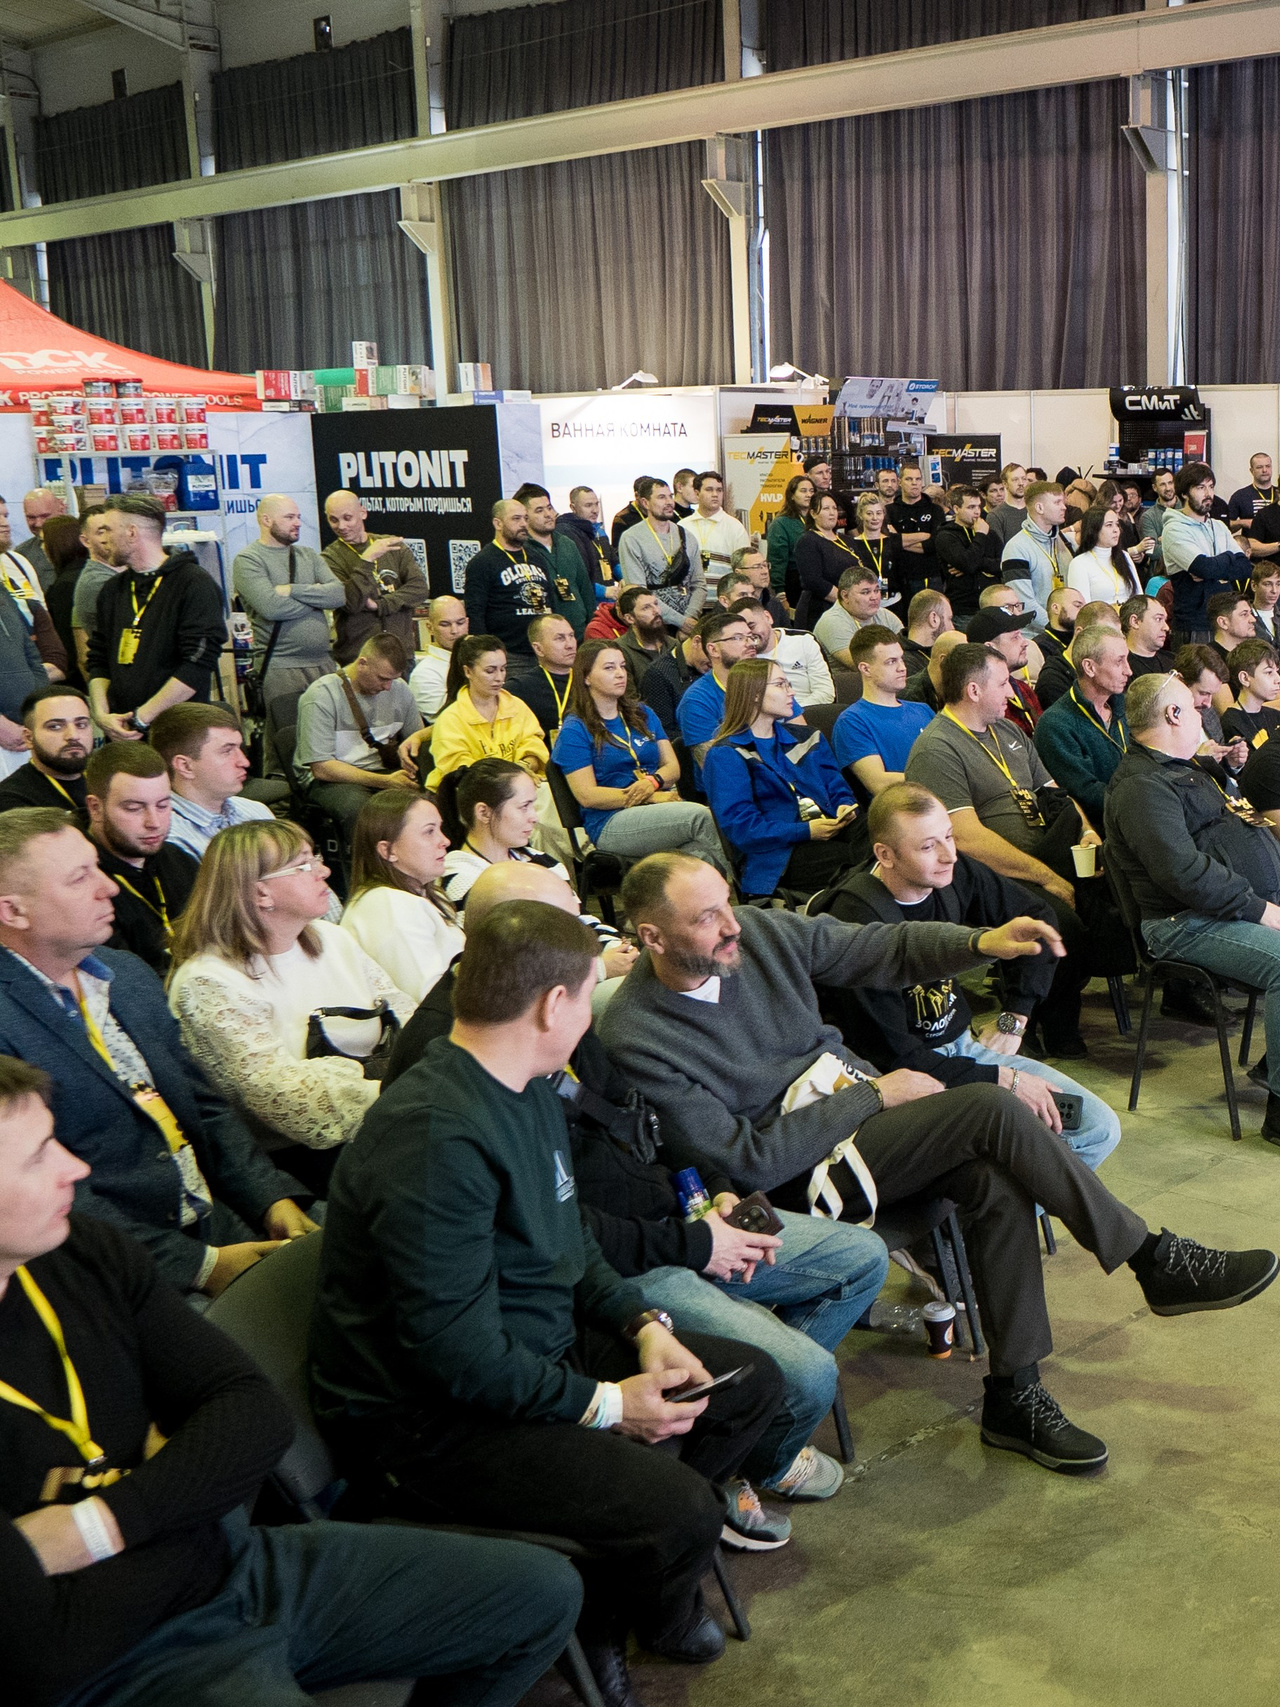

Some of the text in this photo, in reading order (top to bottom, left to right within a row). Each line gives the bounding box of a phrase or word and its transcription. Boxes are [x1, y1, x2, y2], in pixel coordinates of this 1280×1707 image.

[81, 367, 137, 376] TOOLS
[801, 415, 828, 424] WAGNER
[551, 423, 688, 438] ВАННАЯ КОМНАТА
[727, 448, 789, 461] TECMASTER
[932, 446, 997, 459] TECMASTER
[338, 450, 469, 488] PLITONIT
[760, 493, 783, 502] HVLP
[386, 498, 422, 513] КОТОРЫМ
[423, 498, 473, 515] ГОРДИШЬСЯ
[920, 514, 931, 522] 69
